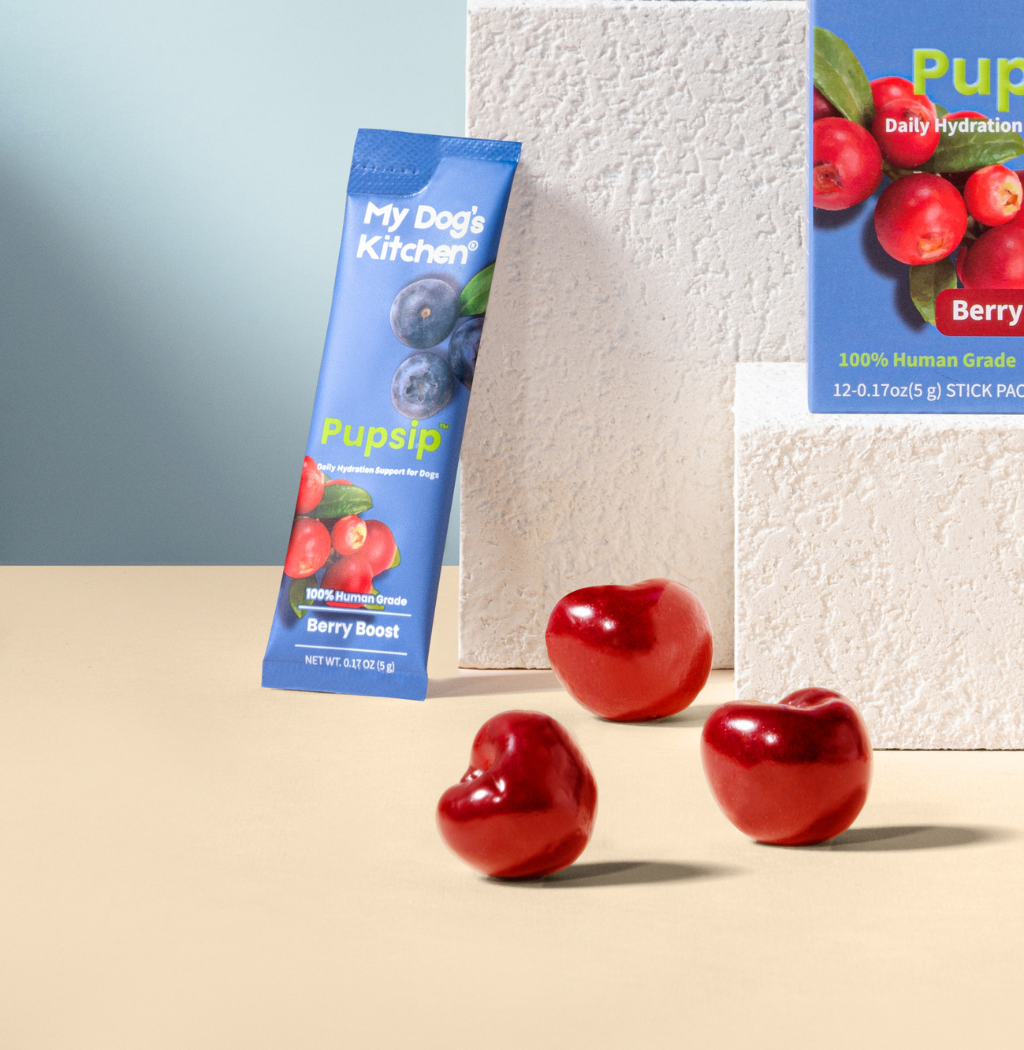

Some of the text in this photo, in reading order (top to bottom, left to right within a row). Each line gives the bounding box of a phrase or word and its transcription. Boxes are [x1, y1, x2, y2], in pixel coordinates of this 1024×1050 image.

[885, 117, 931, 137] Daily
[934, 117, 1023, 136] Hydration
[363, 201, 485, 239] My Dog's
[952, 300, 1024, 326] Berry
[838, 352, 889, 367] 100%
[893, 352, 958, 368] Human
[962, 352, 1016, 368] Grade
[946, 383, 993, 398] STICK
[316, 463, 439, 480] Daily Hydration Support for Dogs
[306, 588, 407, 606] 100% Human Grade
[307, 617, 400, 639] Berry Boost
[305, 655, 324, 665] NET
[325, 656, 341, 667] WT.
[343, 658, 361, 669] 0.17
[363, 659, 375, 670] OZ
